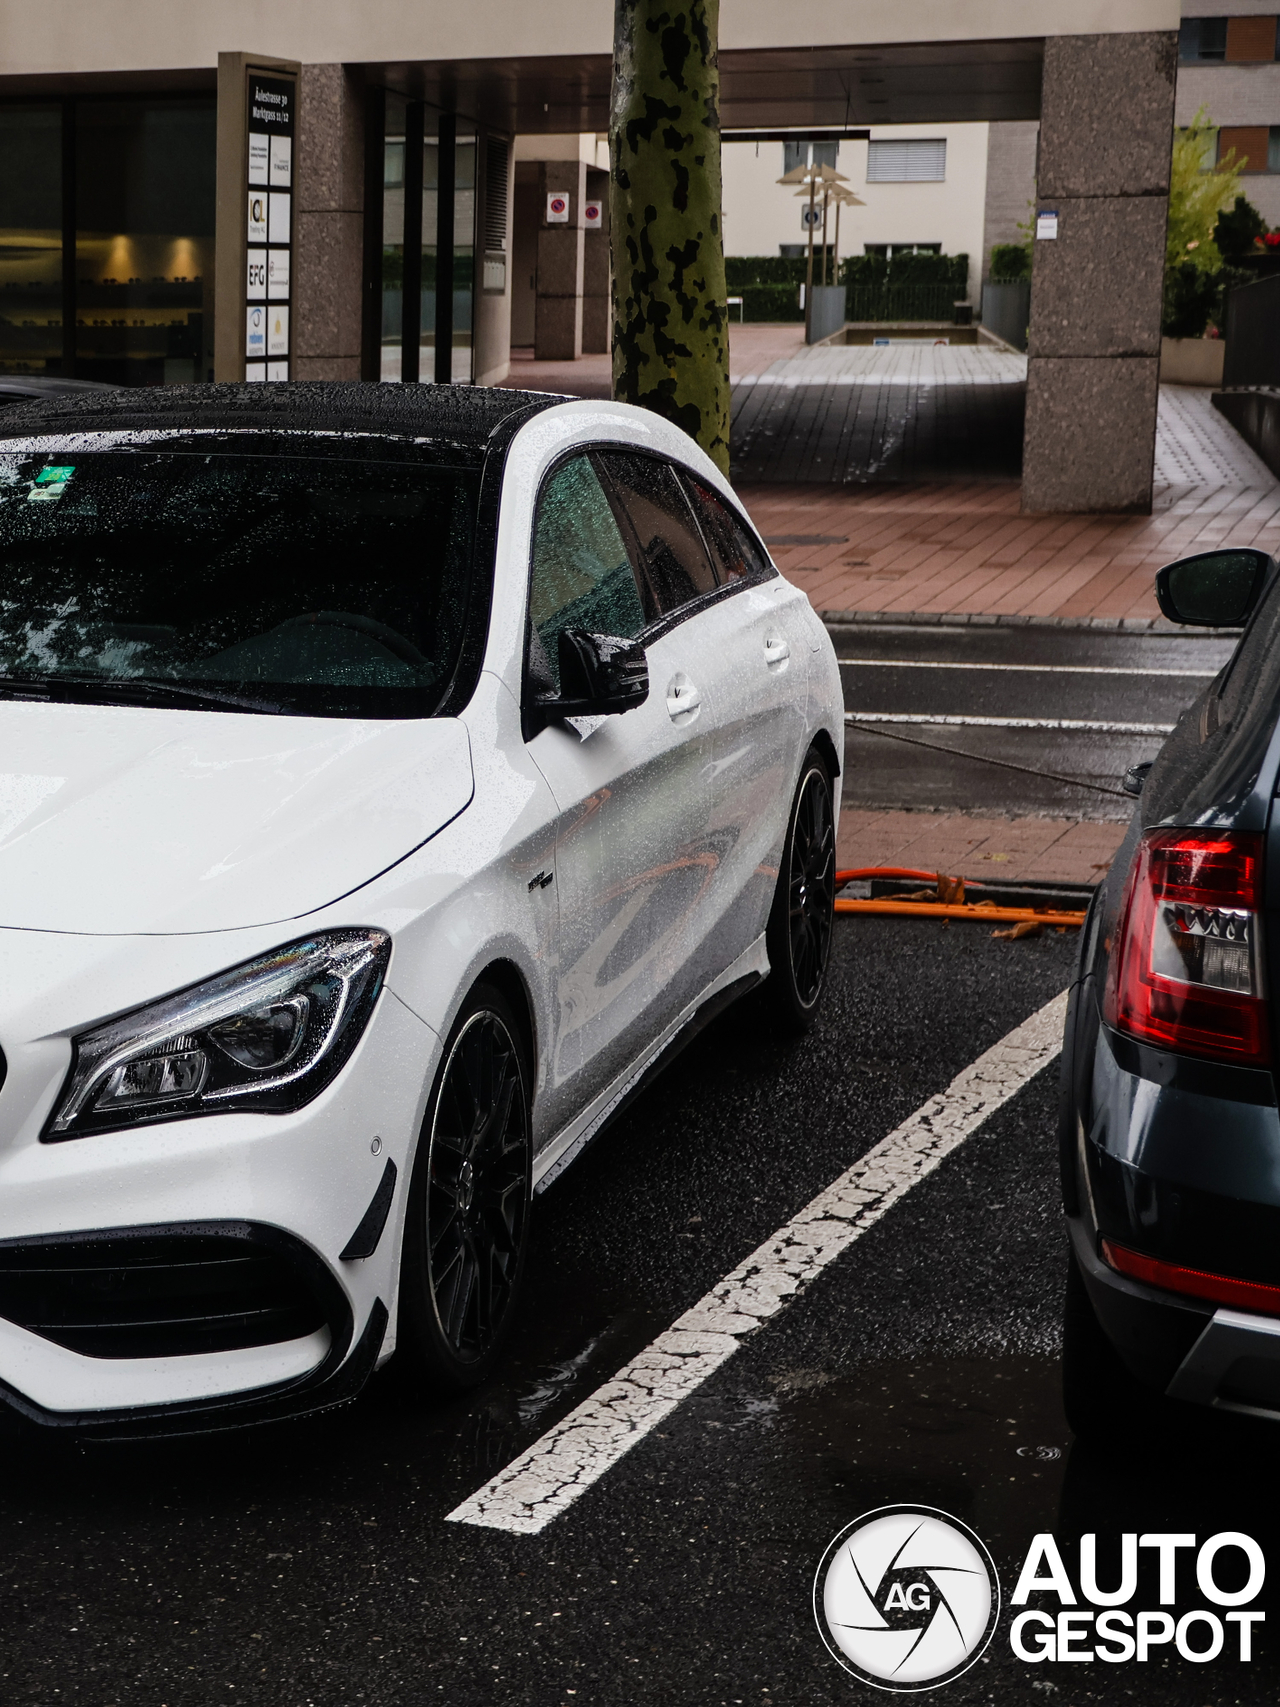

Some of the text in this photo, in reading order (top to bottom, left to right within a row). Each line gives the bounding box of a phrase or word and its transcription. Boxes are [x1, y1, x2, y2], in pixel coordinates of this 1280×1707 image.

[255, 86, 288, 107] Äulestrasse 30
[252, 106, 275, 123] Marktgass
[249, 264, 264, 286] EFG
